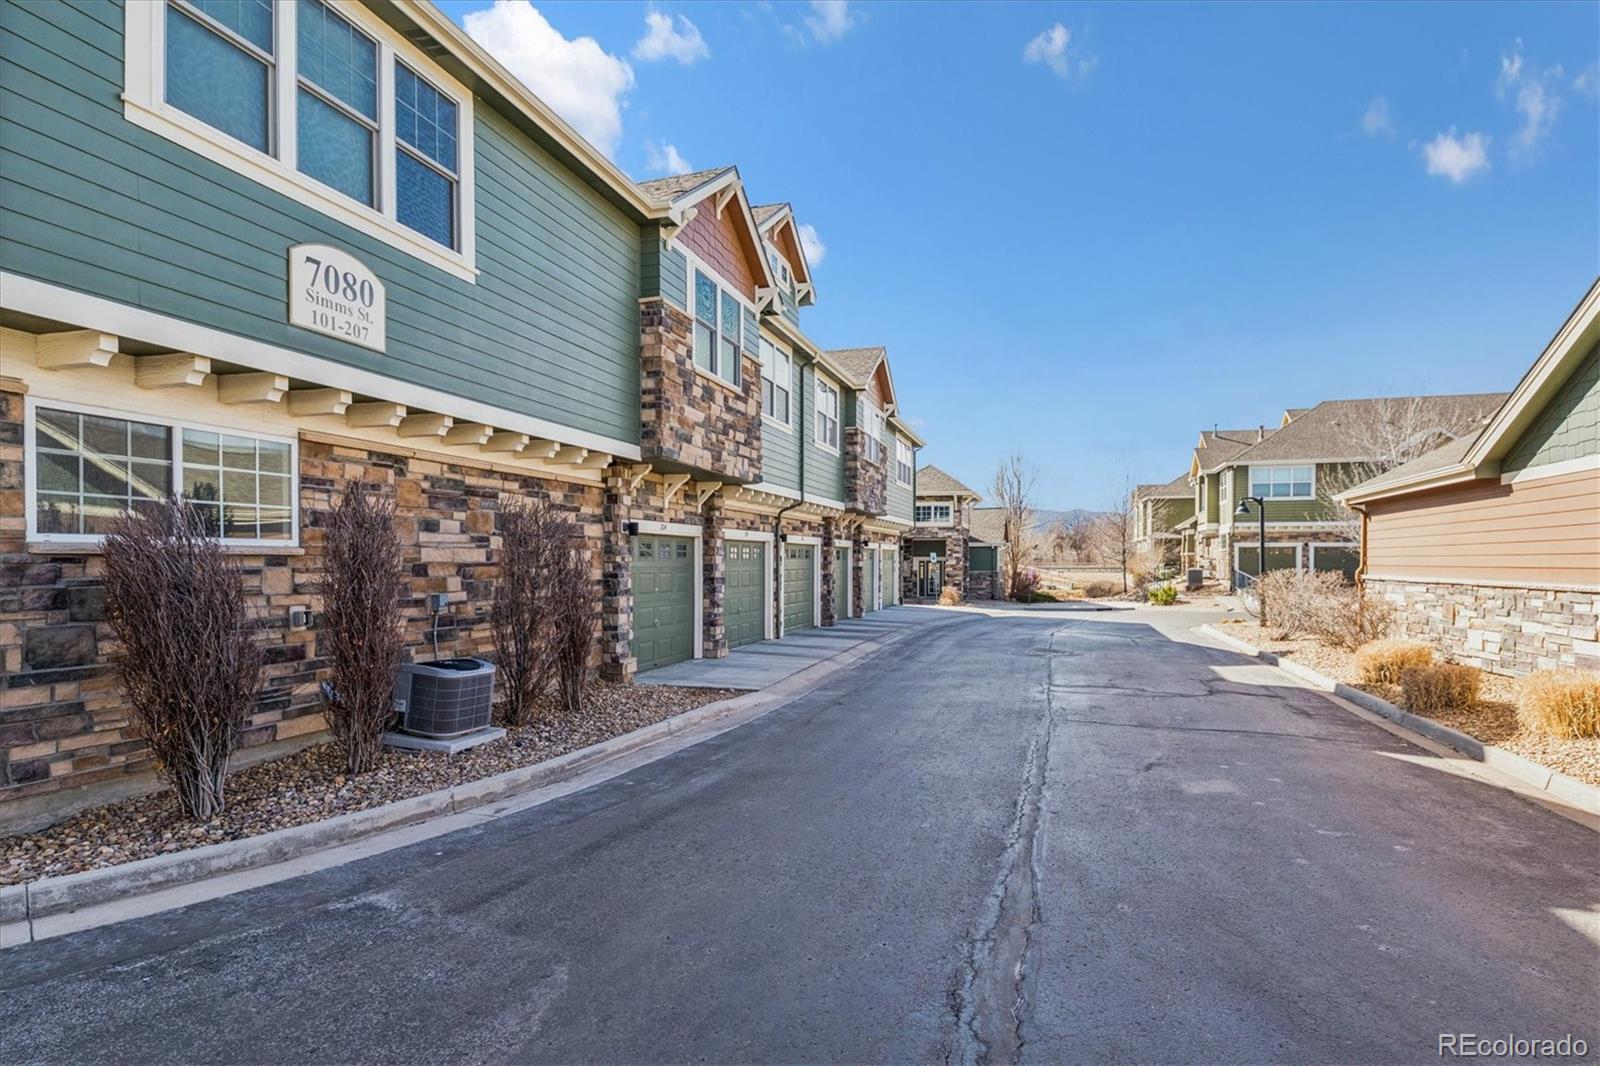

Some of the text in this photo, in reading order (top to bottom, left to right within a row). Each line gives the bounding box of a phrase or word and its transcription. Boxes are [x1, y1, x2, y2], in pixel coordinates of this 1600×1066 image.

[304, 255, 374, 308] 7080
[305, 288, 374, 325] Simms St.
[312, 310, 369, 341] 101-207
